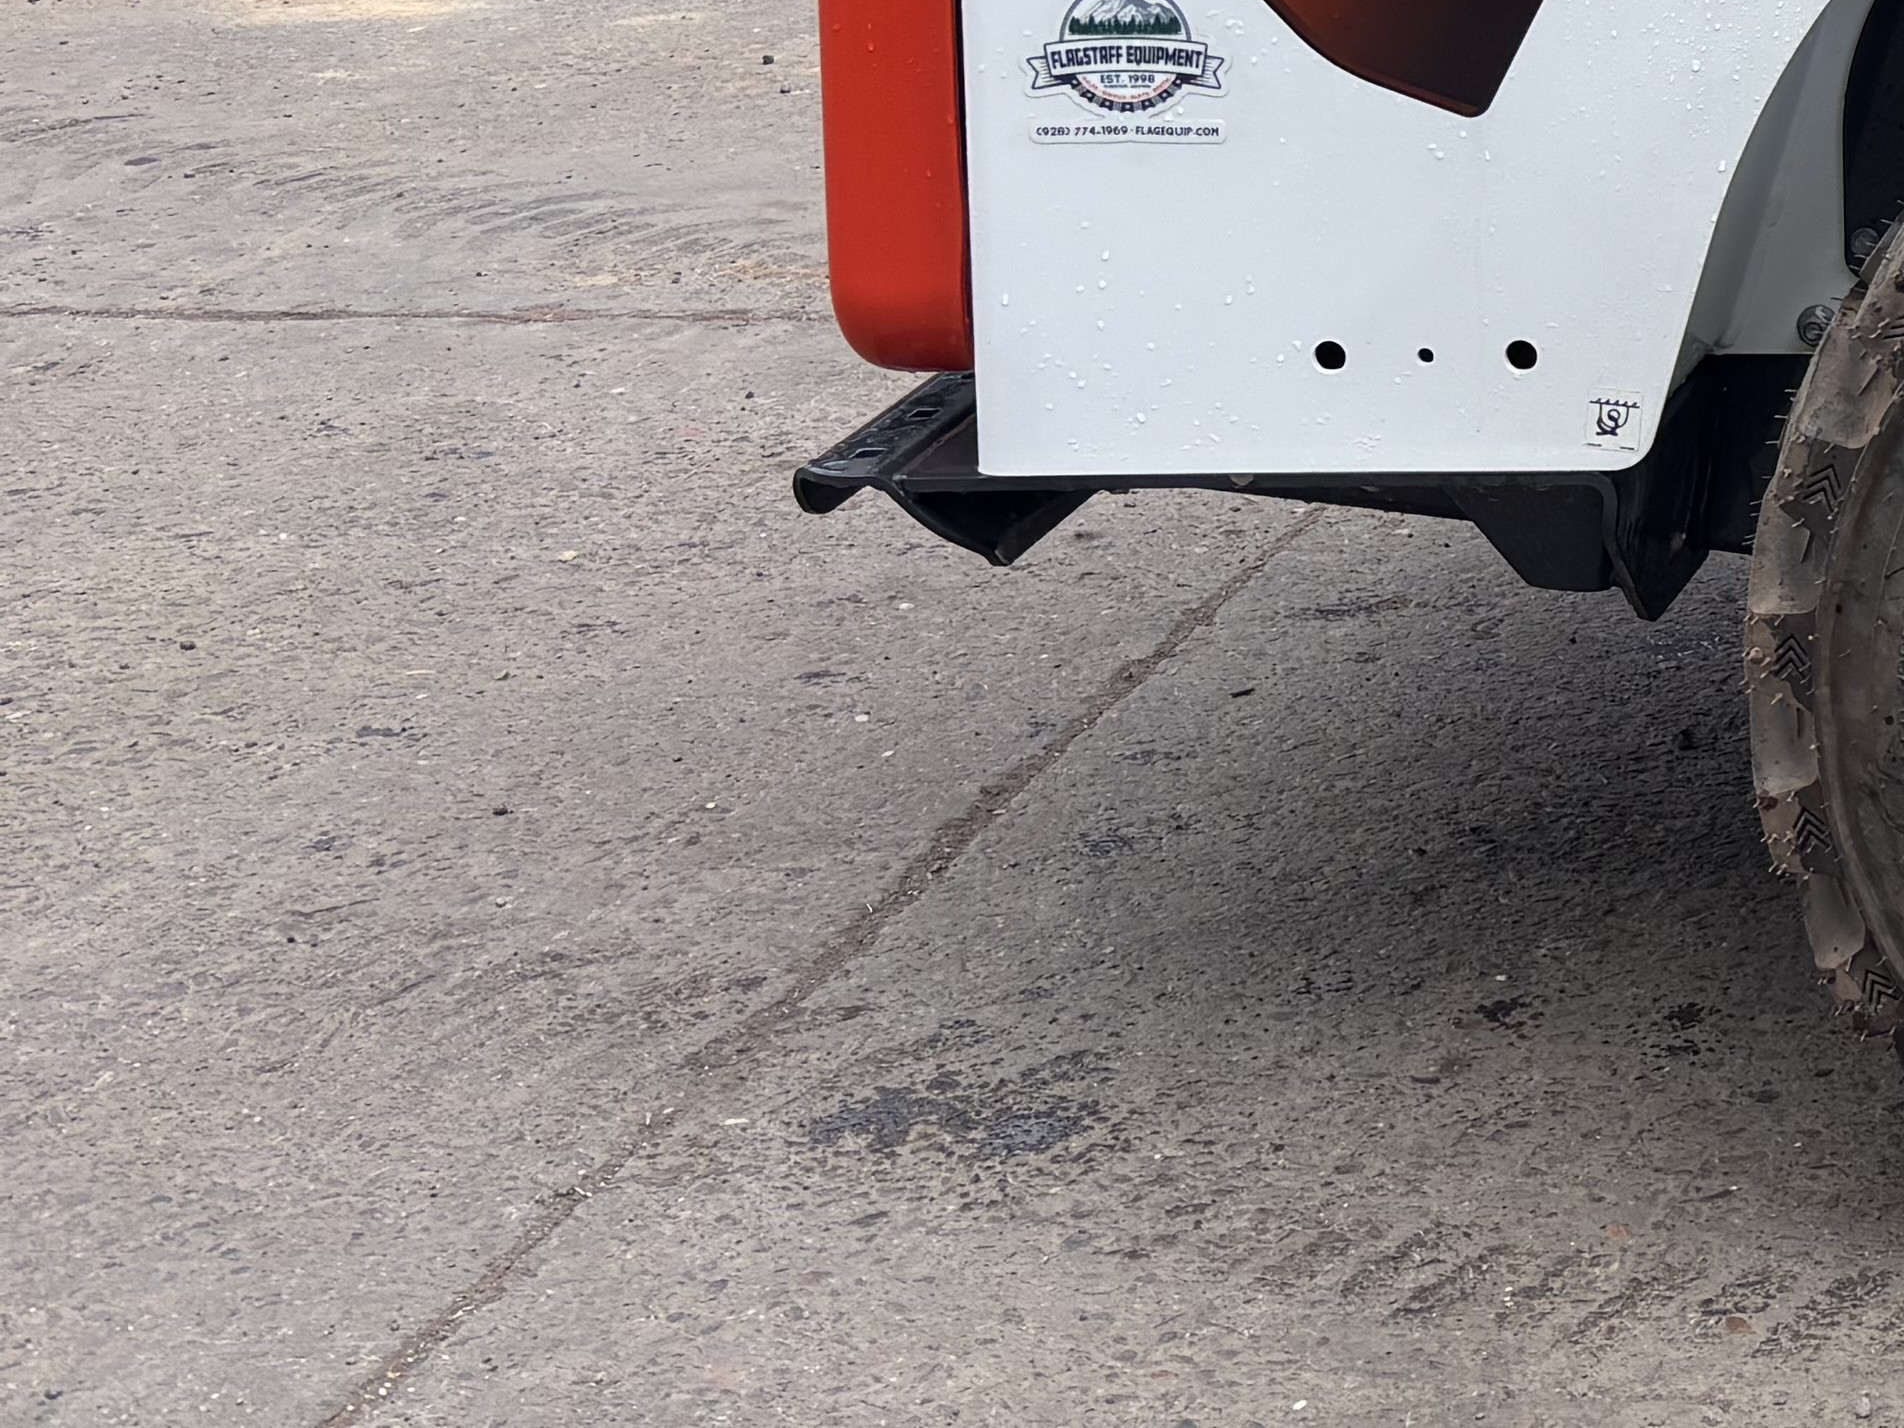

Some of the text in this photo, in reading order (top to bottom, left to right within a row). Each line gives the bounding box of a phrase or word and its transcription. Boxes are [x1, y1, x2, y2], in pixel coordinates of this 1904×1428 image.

[1051, 45, 1202, 70] FLAGSTAFF EQUIPMENT
[1100, 74, 1125, 84] EST.
[1036, 125, 1220, 138] (928) 774-1969 FLAGEQUIP.COM
